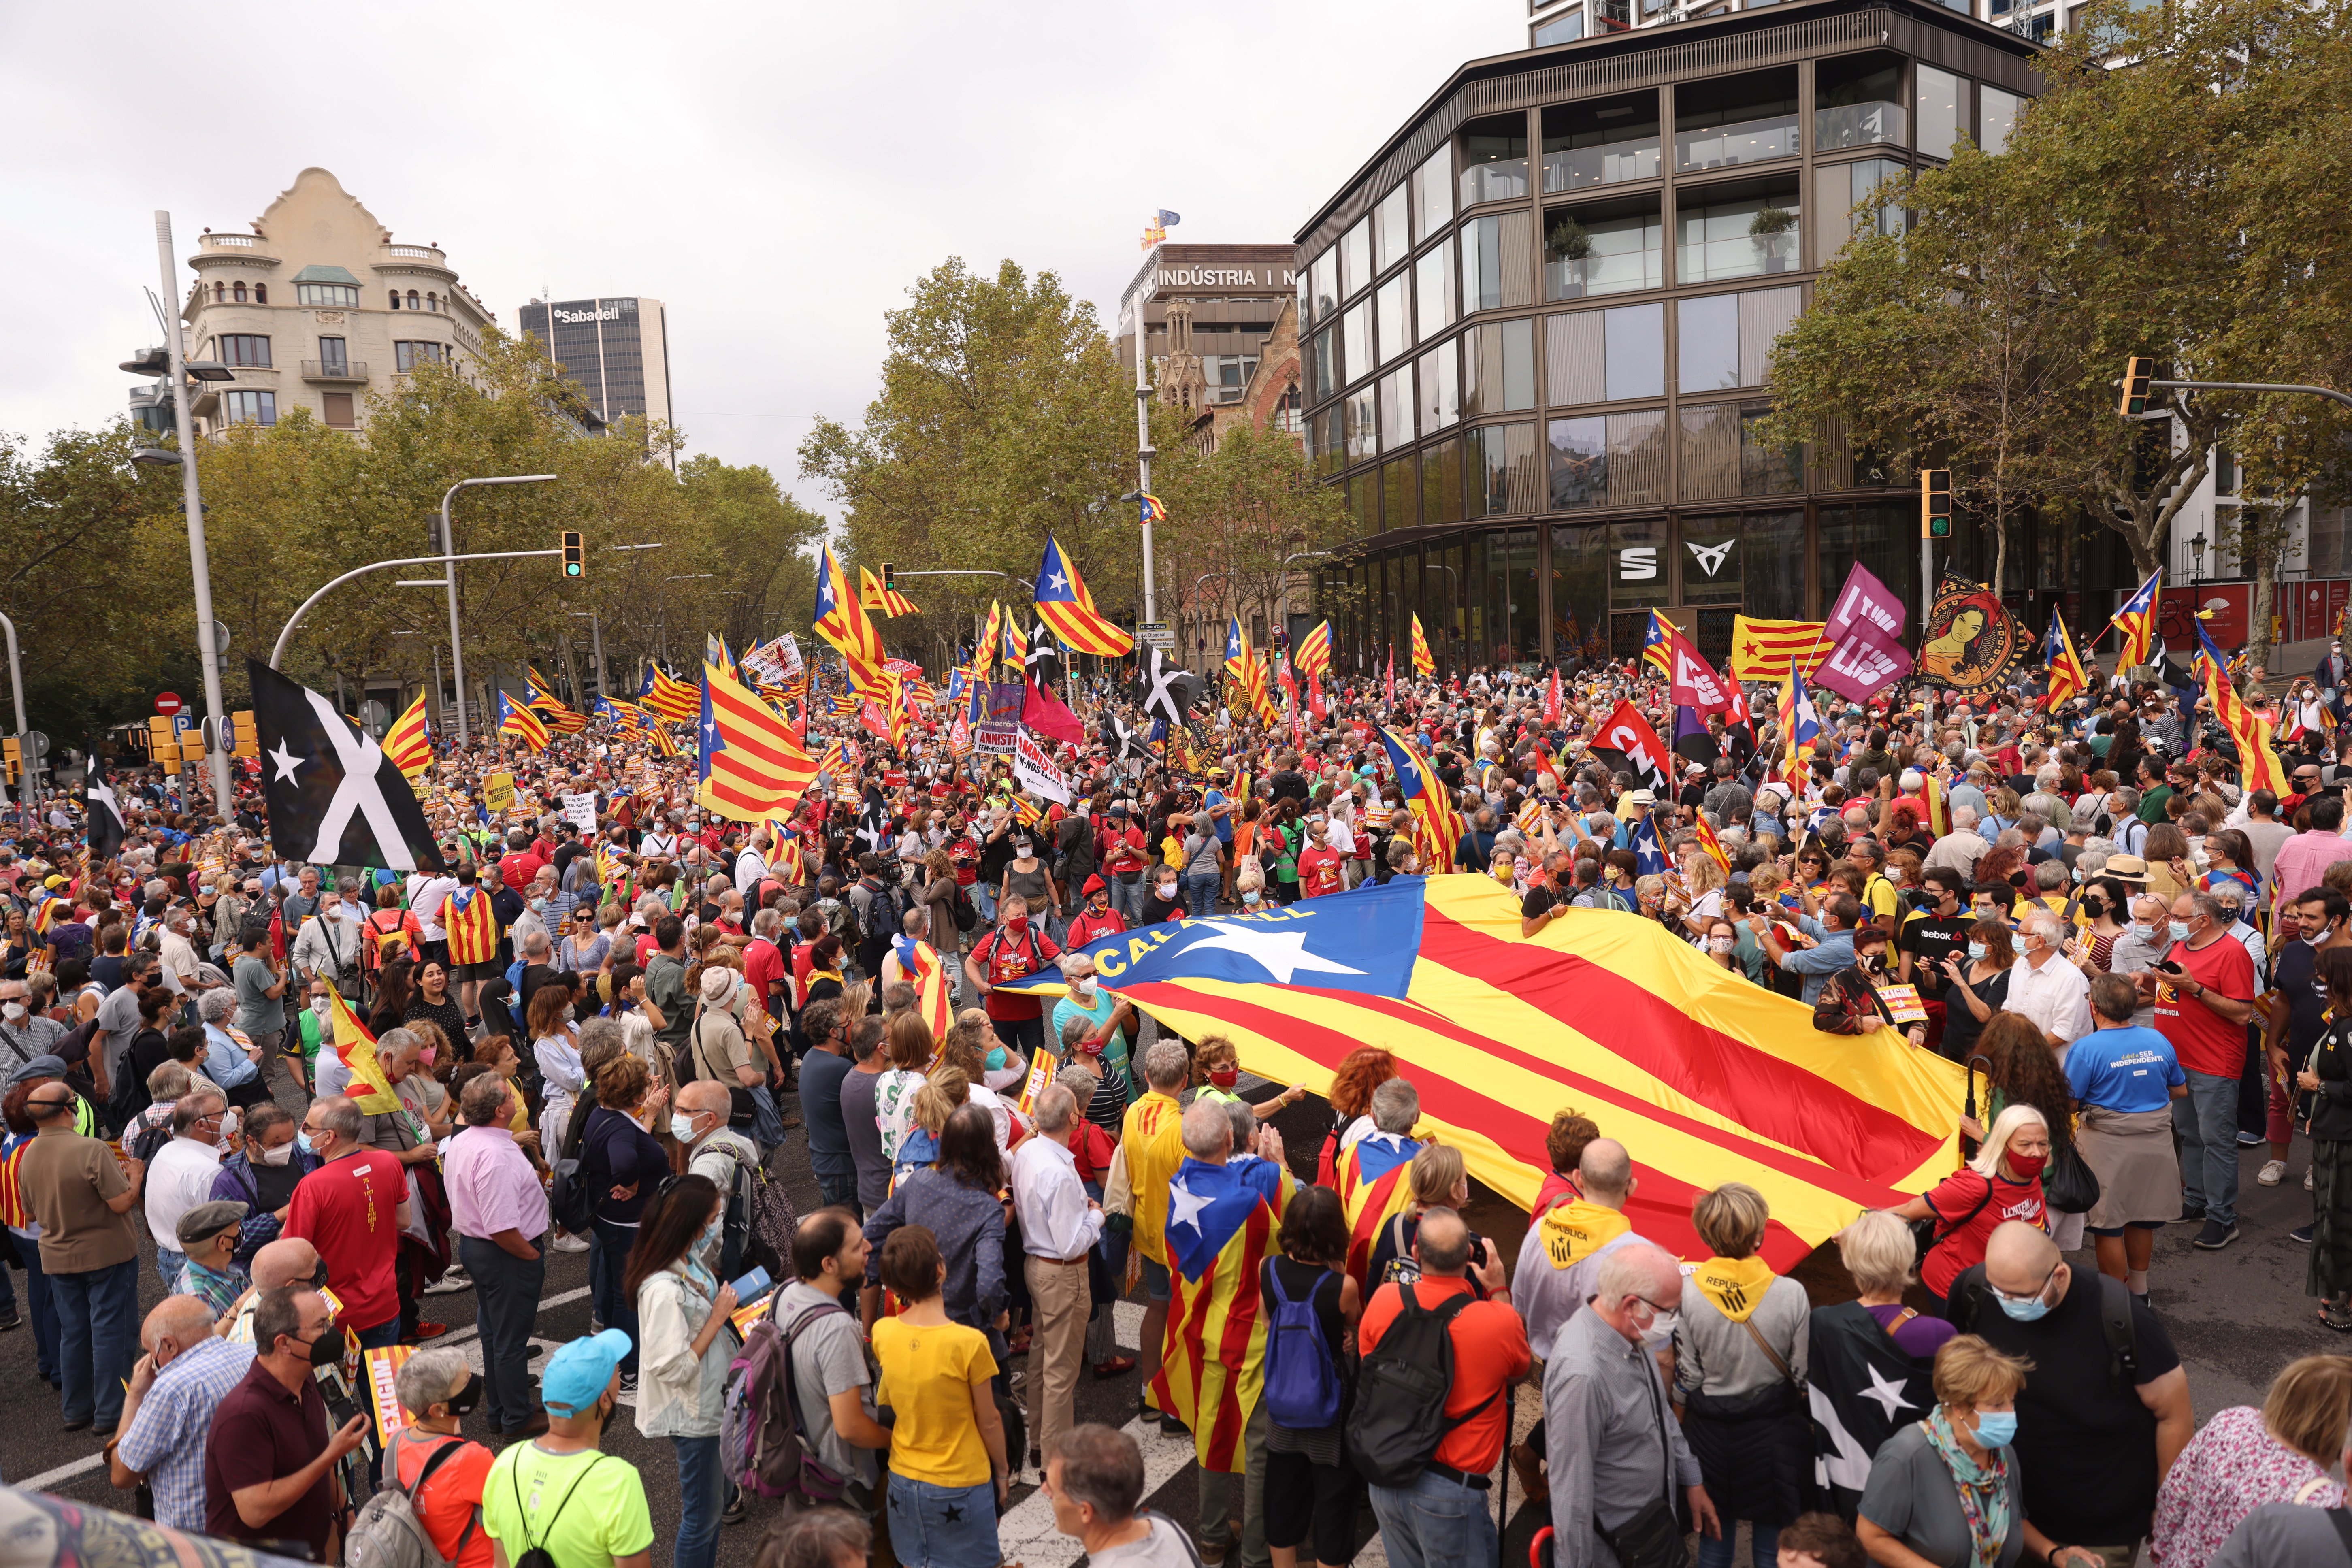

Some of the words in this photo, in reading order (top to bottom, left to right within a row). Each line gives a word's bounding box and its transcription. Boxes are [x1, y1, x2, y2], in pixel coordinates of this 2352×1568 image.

[1159, 265, 1256, 285] INDÚSTRIA
[1267, 271, 1272, 285] I
[562, 307, 619, 323] Sabadell
[1119, 305, 1133, 330] CAMBRA
[177, 718, 189, 735] P
[954, 743, 969, 751] EXIGIM
[1611, 725, 1666, 792] CNT
[641, 782, 656, 792] EXIGIM
[489, 790, 513, 804] LLIBERTAT
[204, 859, 217, 867] HEM
[1091, 927, 1106, 937] LLUITEM
[1100, 928, 1115, 937] GUANYEM
[1895, 999, 1906, 1008] LA
[2110, 1055, 2164, 1068] INDEPENDENTS
[1027, 1067, 1046, 1098] HEM
[2002, 1198, 2030, 1219] LLUITEM
[372, 1359, 402, 1434] EXIGIM
